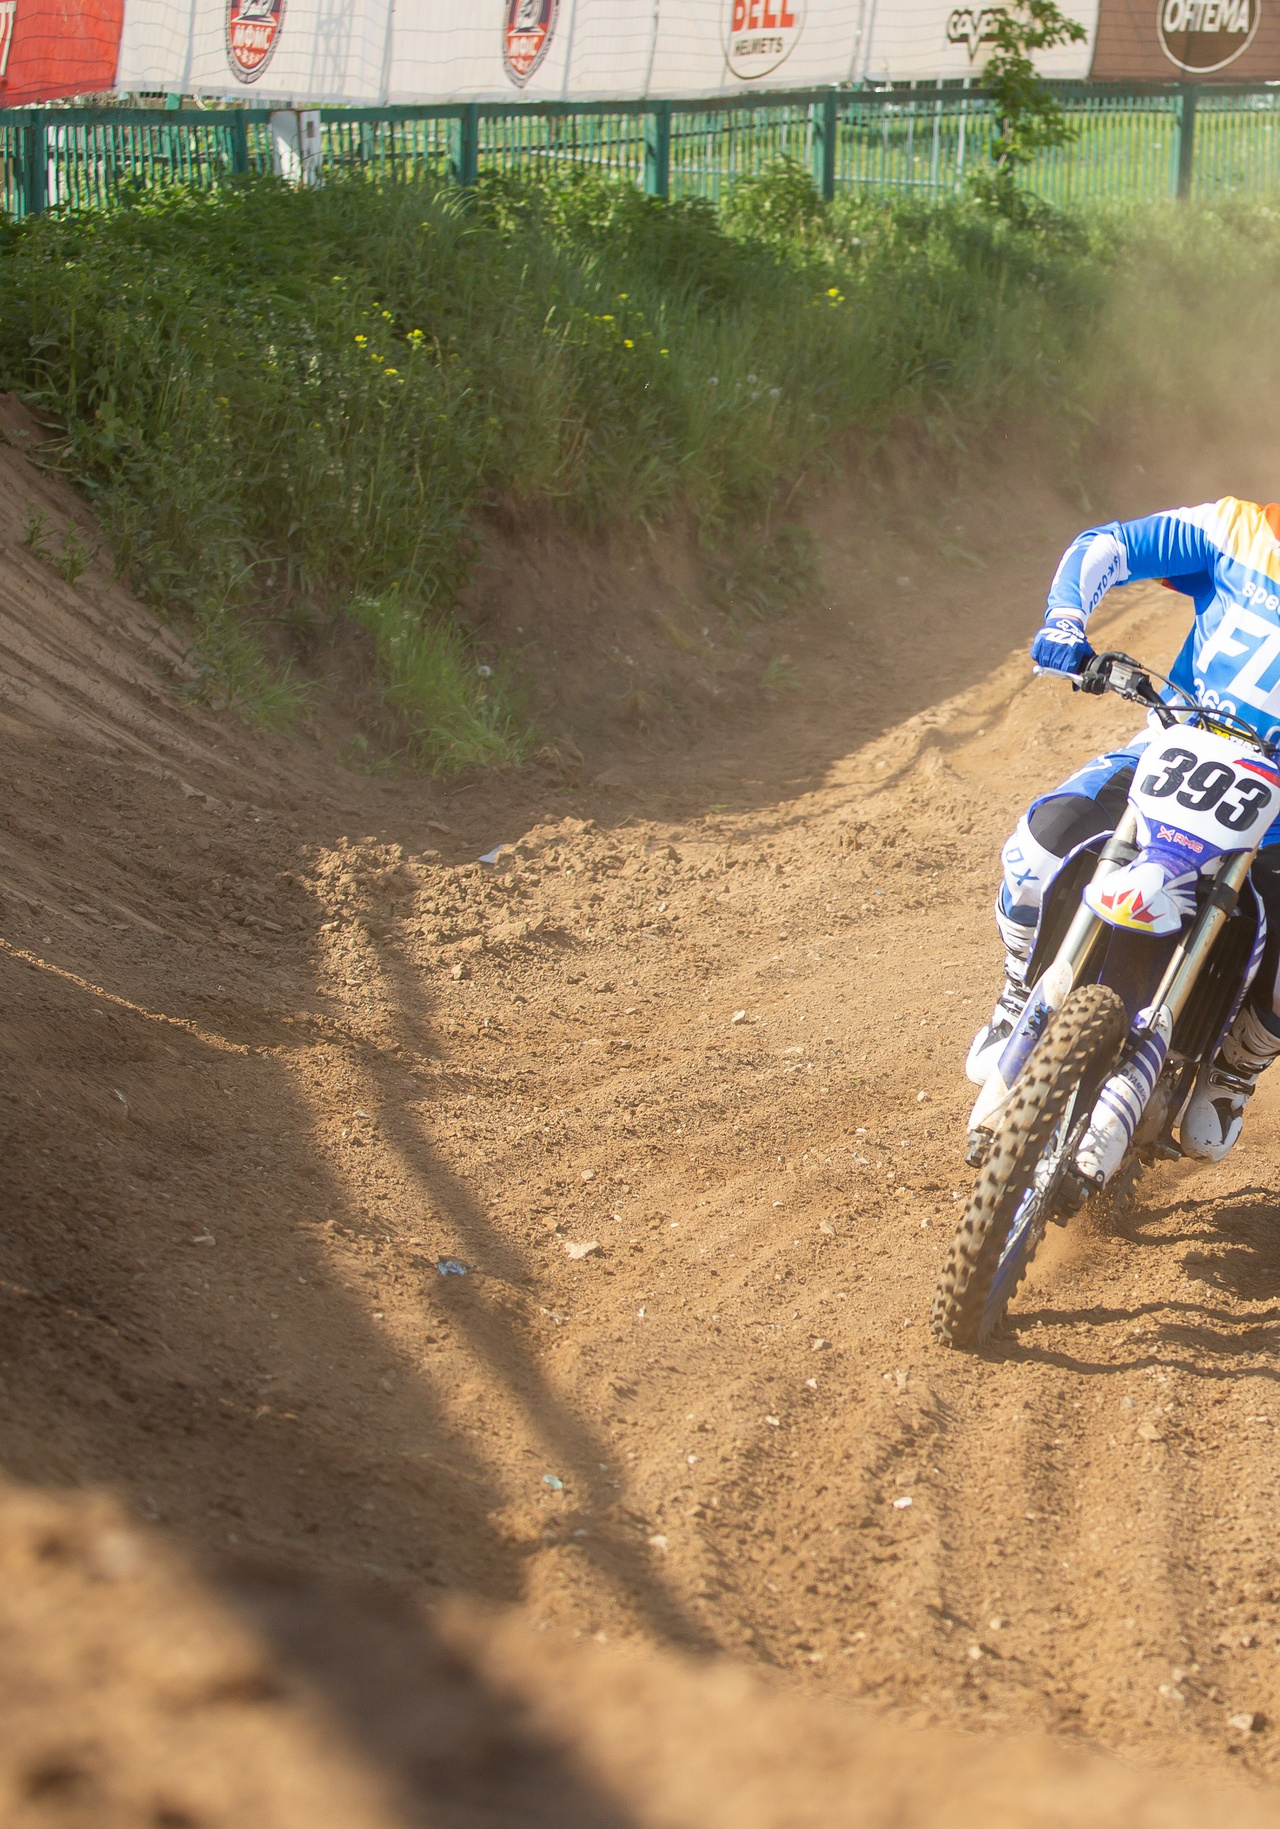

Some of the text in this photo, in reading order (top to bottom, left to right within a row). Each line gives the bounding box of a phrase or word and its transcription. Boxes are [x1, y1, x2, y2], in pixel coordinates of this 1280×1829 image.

[1163, 0, 1250, 33] ORTEMA
[1140, 747, 1272, 832] 393
[1005, 846, 1040, 887] OX
